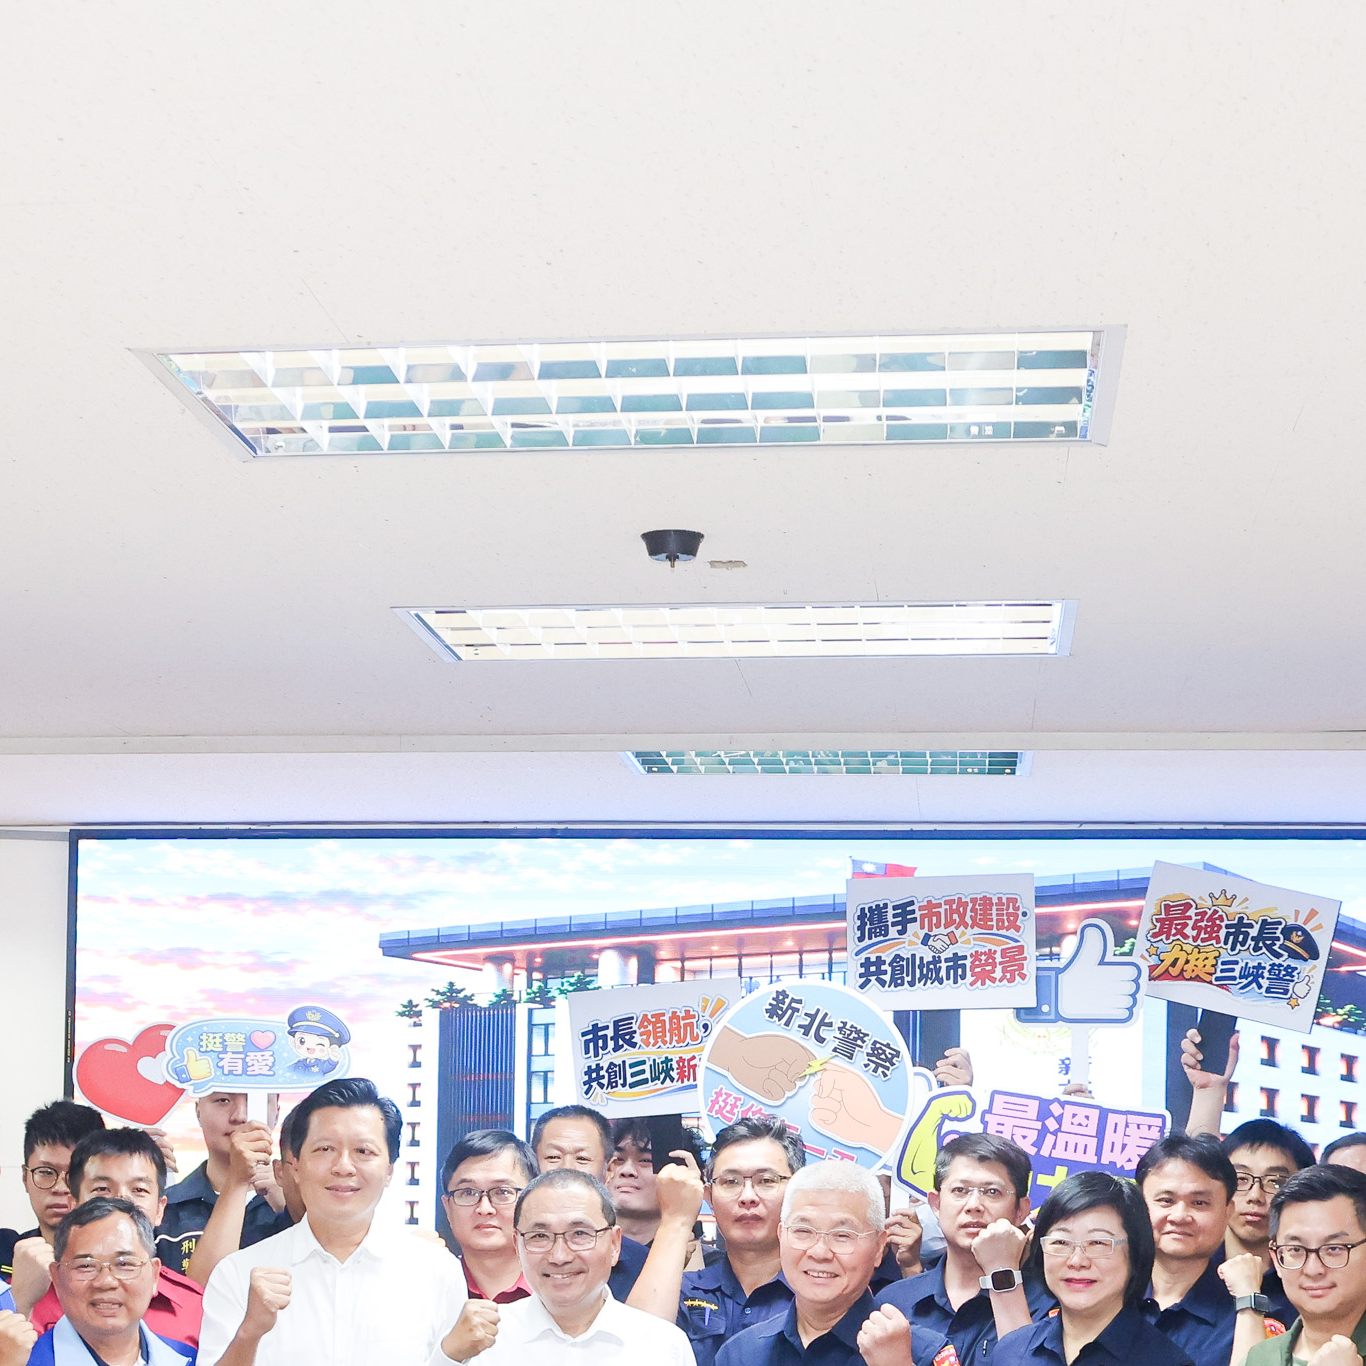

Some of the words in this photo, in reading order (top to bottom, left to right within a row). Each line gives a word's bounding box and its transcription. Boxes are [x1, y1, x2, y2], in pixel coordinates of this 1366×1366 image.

[1151, 901, 1284, 959] 最強市長
[858, 945, 1028, 990] 共創城市榮景
[1150, 944, 1299, 998] 力挺三峽警
[199, 1032, 247, 1052] 挺警
[765, 989, 901, 1079] 新北警察
[217, 1050, 276, 1076] 有愛
[582, 1055, 701, 1096] 共創三峽新
[984, 1093, 1163, 1171] 最溫暖
